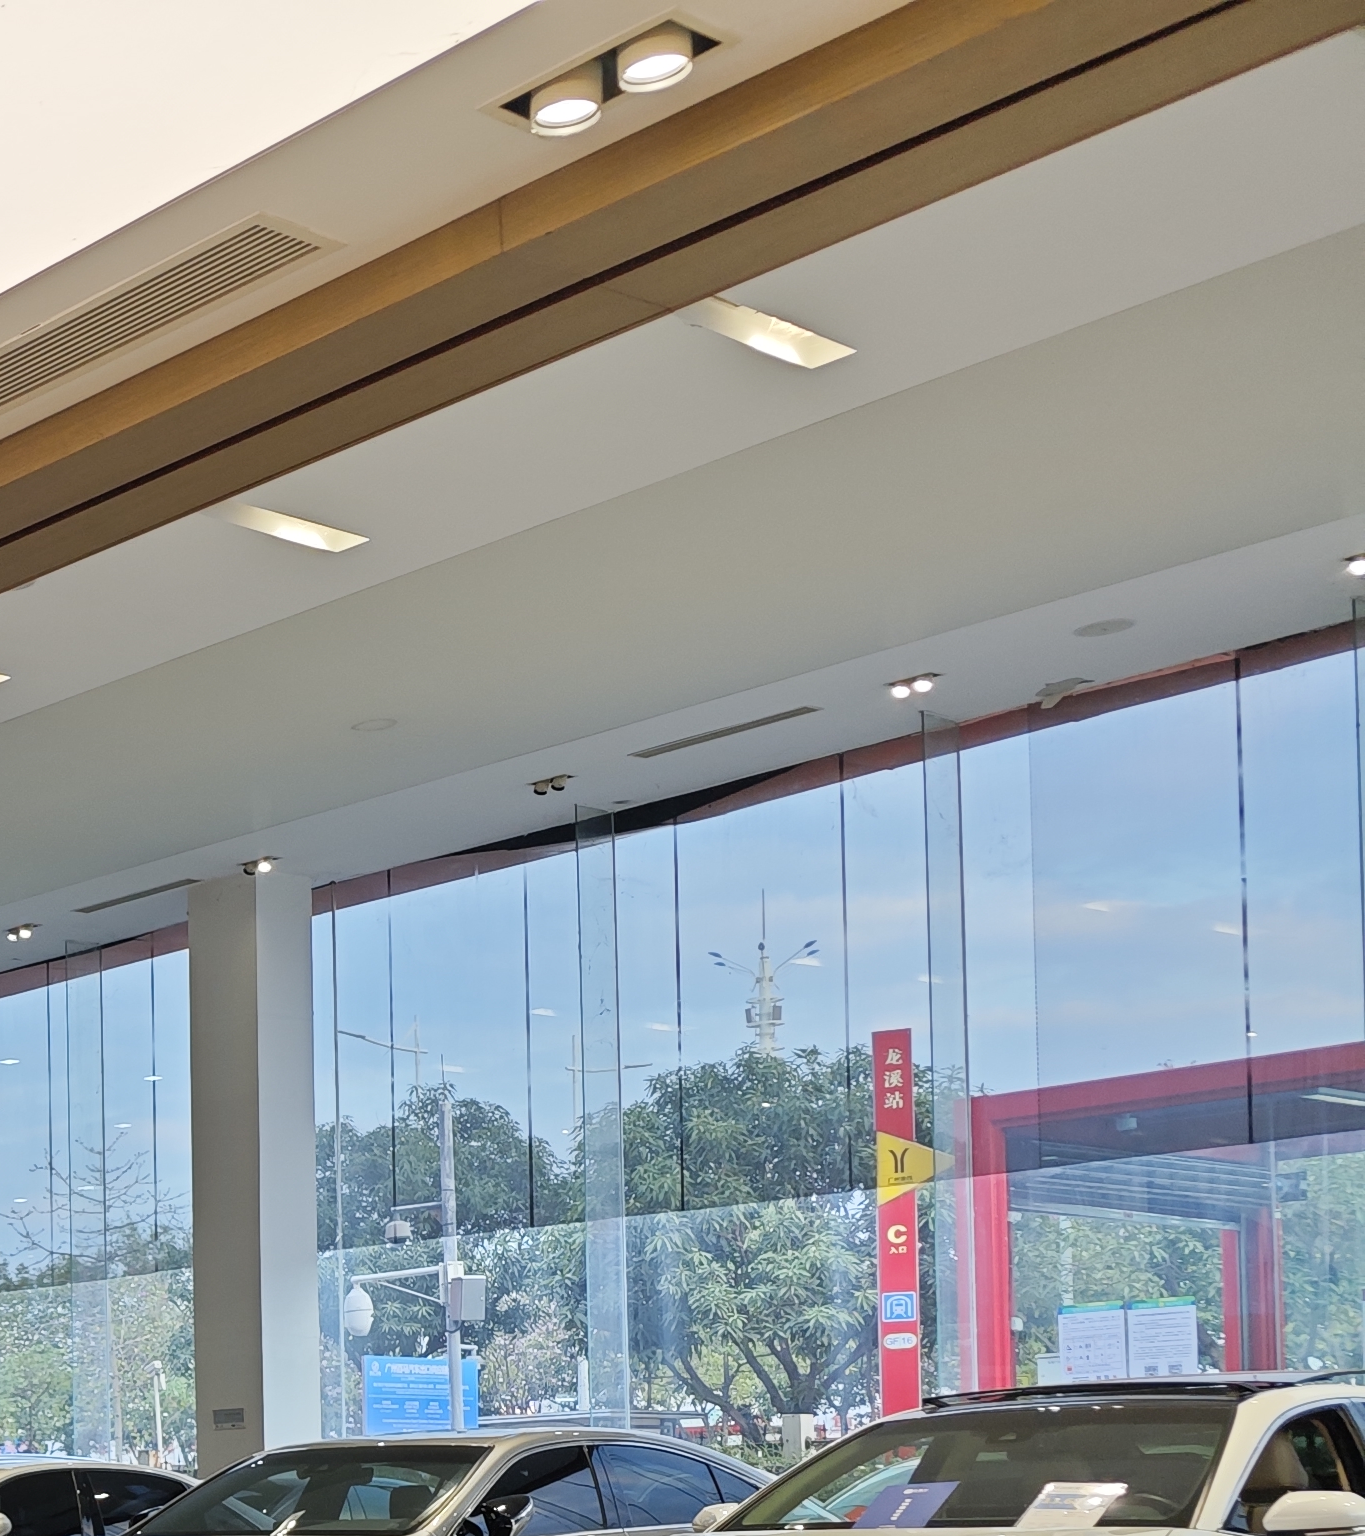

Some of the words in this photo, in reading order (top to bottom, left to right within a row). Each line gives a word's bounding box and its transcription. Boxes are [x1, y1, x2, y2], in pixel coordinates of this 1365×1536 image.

[882, 1048, 904, 1109] 龙溪站
[887, 1224, 908, 1244] C
